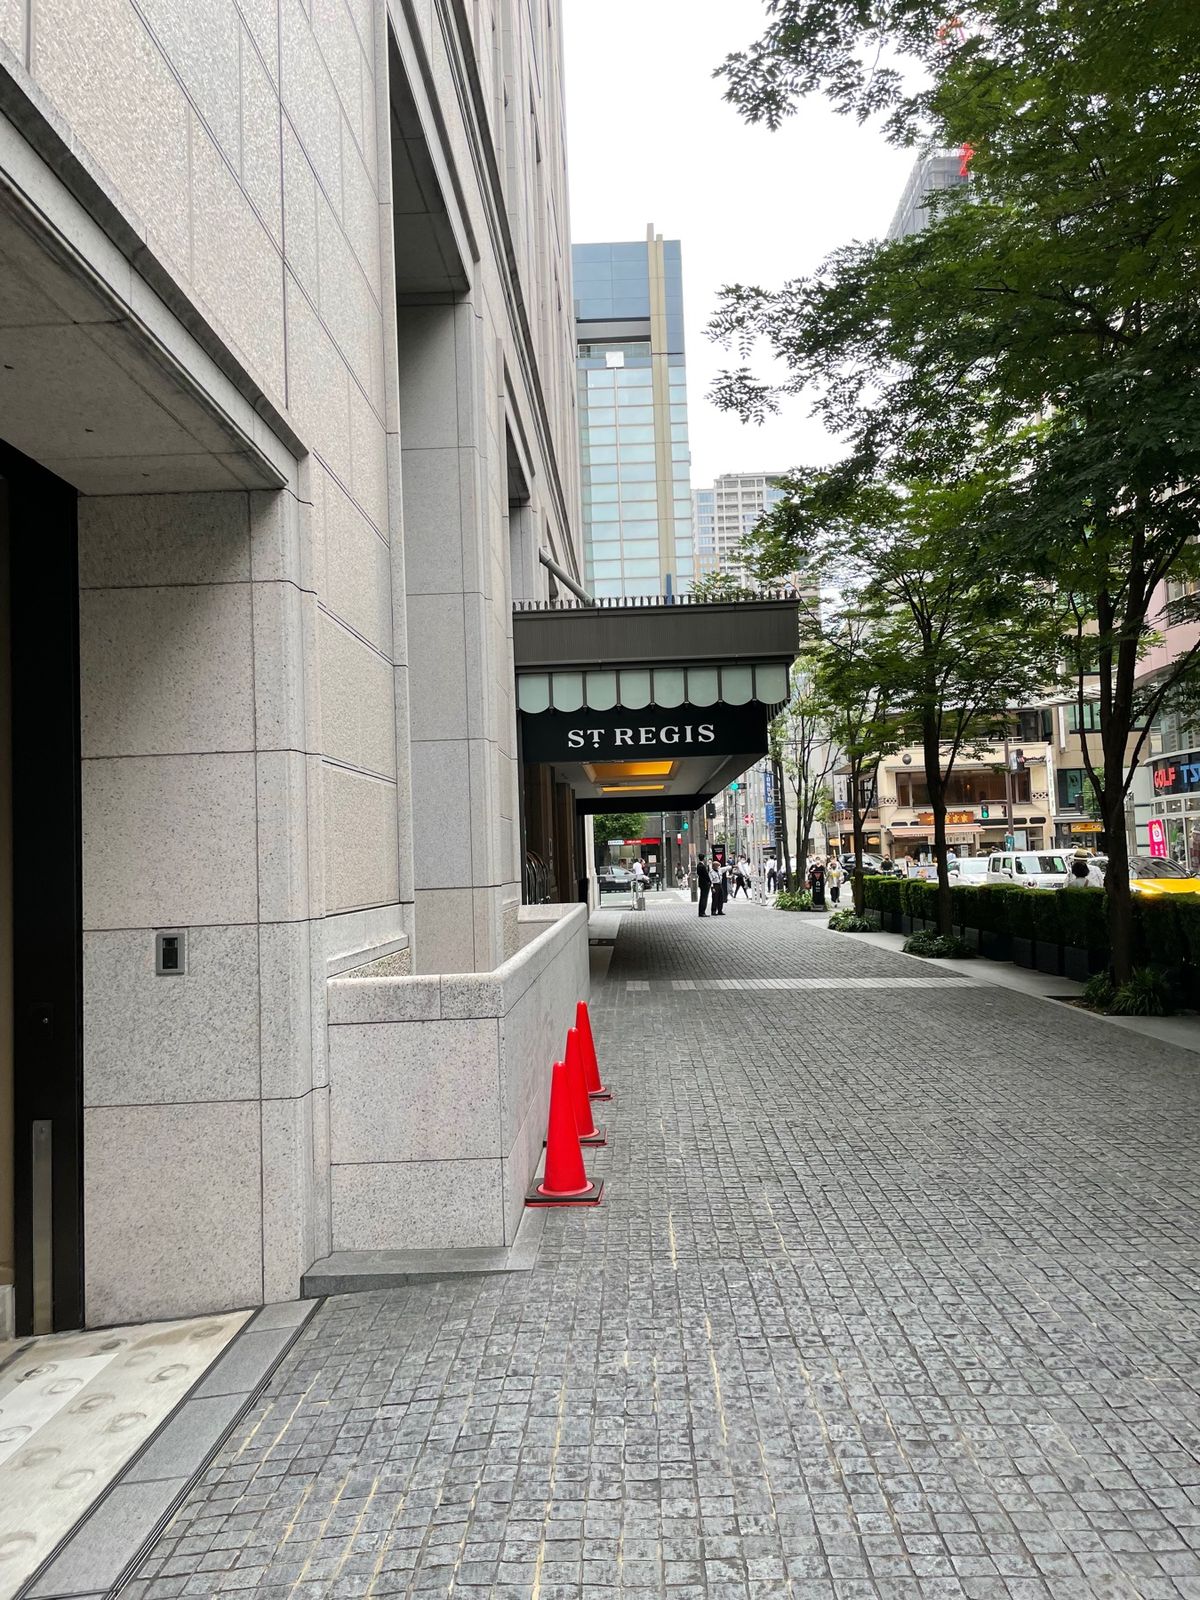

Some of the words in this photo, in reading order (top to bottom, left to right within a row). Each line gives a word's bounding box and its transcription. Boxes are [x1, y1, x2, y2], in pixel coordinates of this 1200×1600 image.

[614, 724, 715, 746] REGIS
[1154, 767, 1176, 788] GOLF
[1180, 763, 1200, 784] TS
